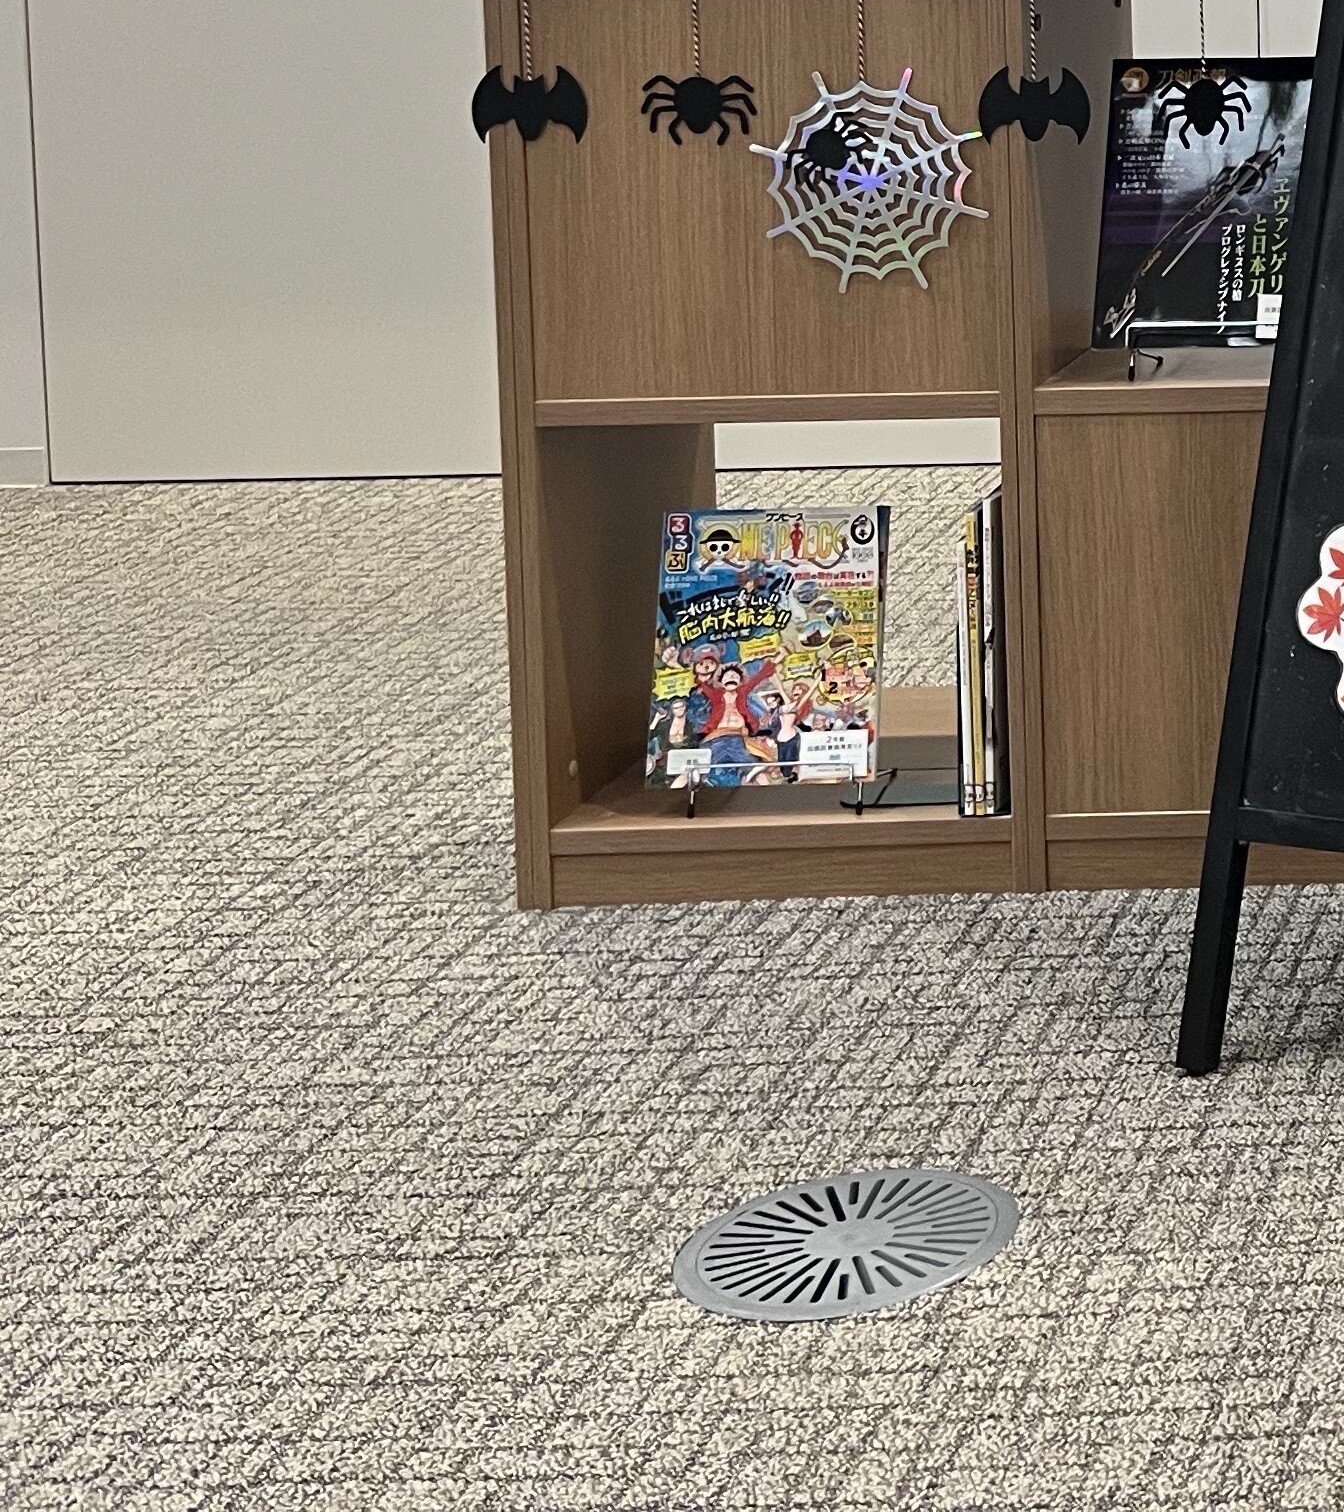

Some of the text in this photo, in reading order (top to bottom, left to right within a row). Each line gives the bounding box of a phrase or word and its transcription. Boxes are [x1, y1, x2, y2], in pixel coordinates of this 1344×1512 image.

[1247, 213, 1267, 298] と日本刀
[667, 516, 689, 569] るるぶ
